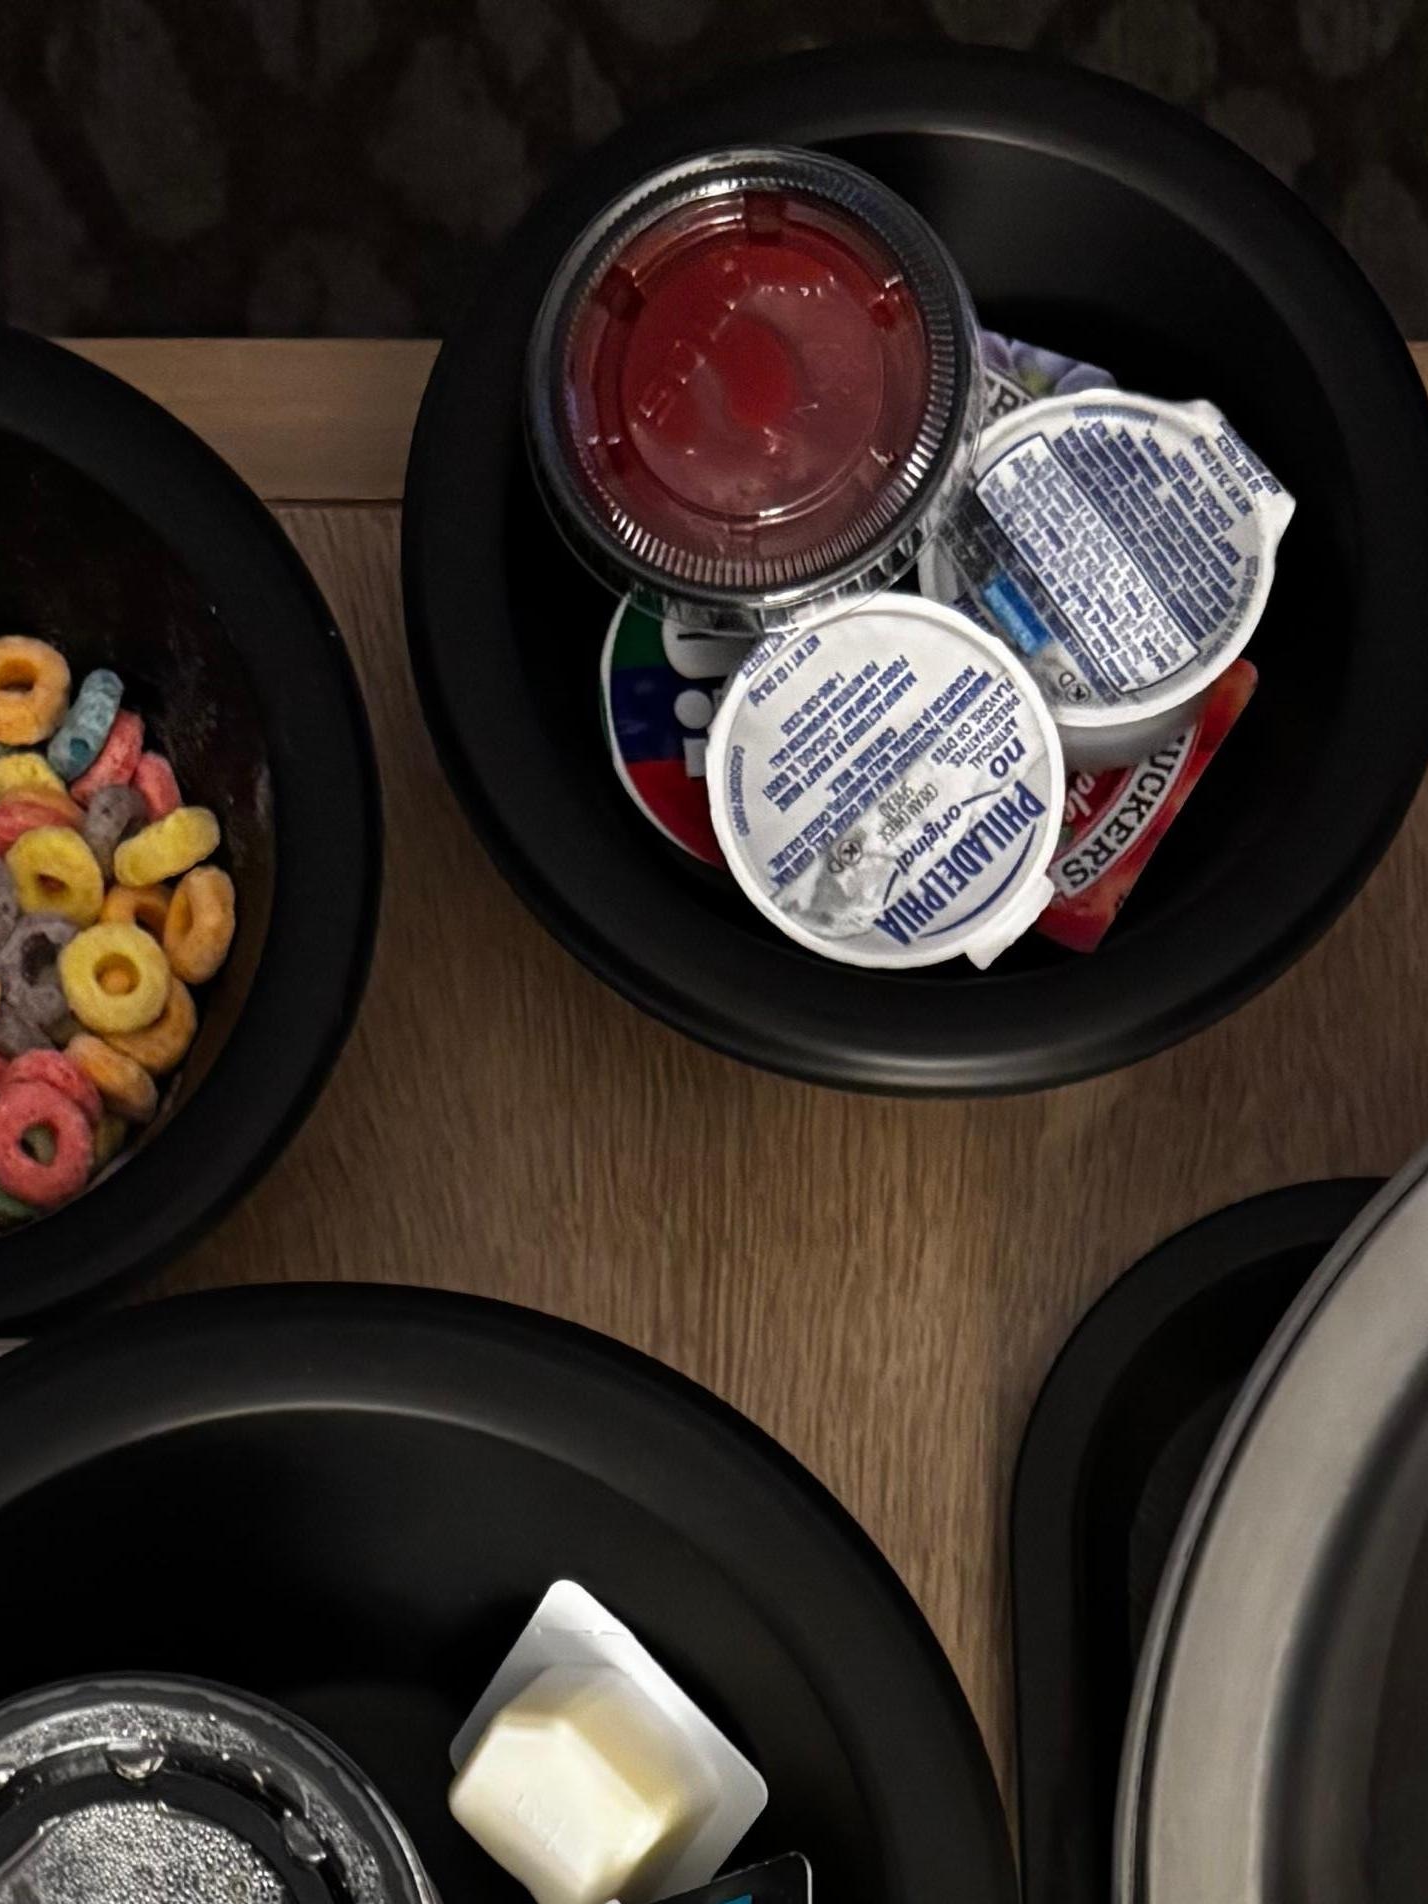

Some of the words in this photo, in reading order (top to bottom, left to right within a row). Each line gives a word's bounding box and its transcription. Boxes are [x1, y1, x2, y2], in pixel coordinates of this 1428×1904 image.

[828, 740, 849, 760] BY
[928, 734, 960, 766] DYES
[952, 720, 973, 742] OR
[965, 715, 1022, 772] ARTIFICIAL
[799, 753, 835, 788] KRAFT
[983, 735, 1031, 782] no
[889, 799, 967, 878] original
[1060, 751, 1179, 887] UCKER'S
[874, 781, 1046, 946] PHILADELPHIA
